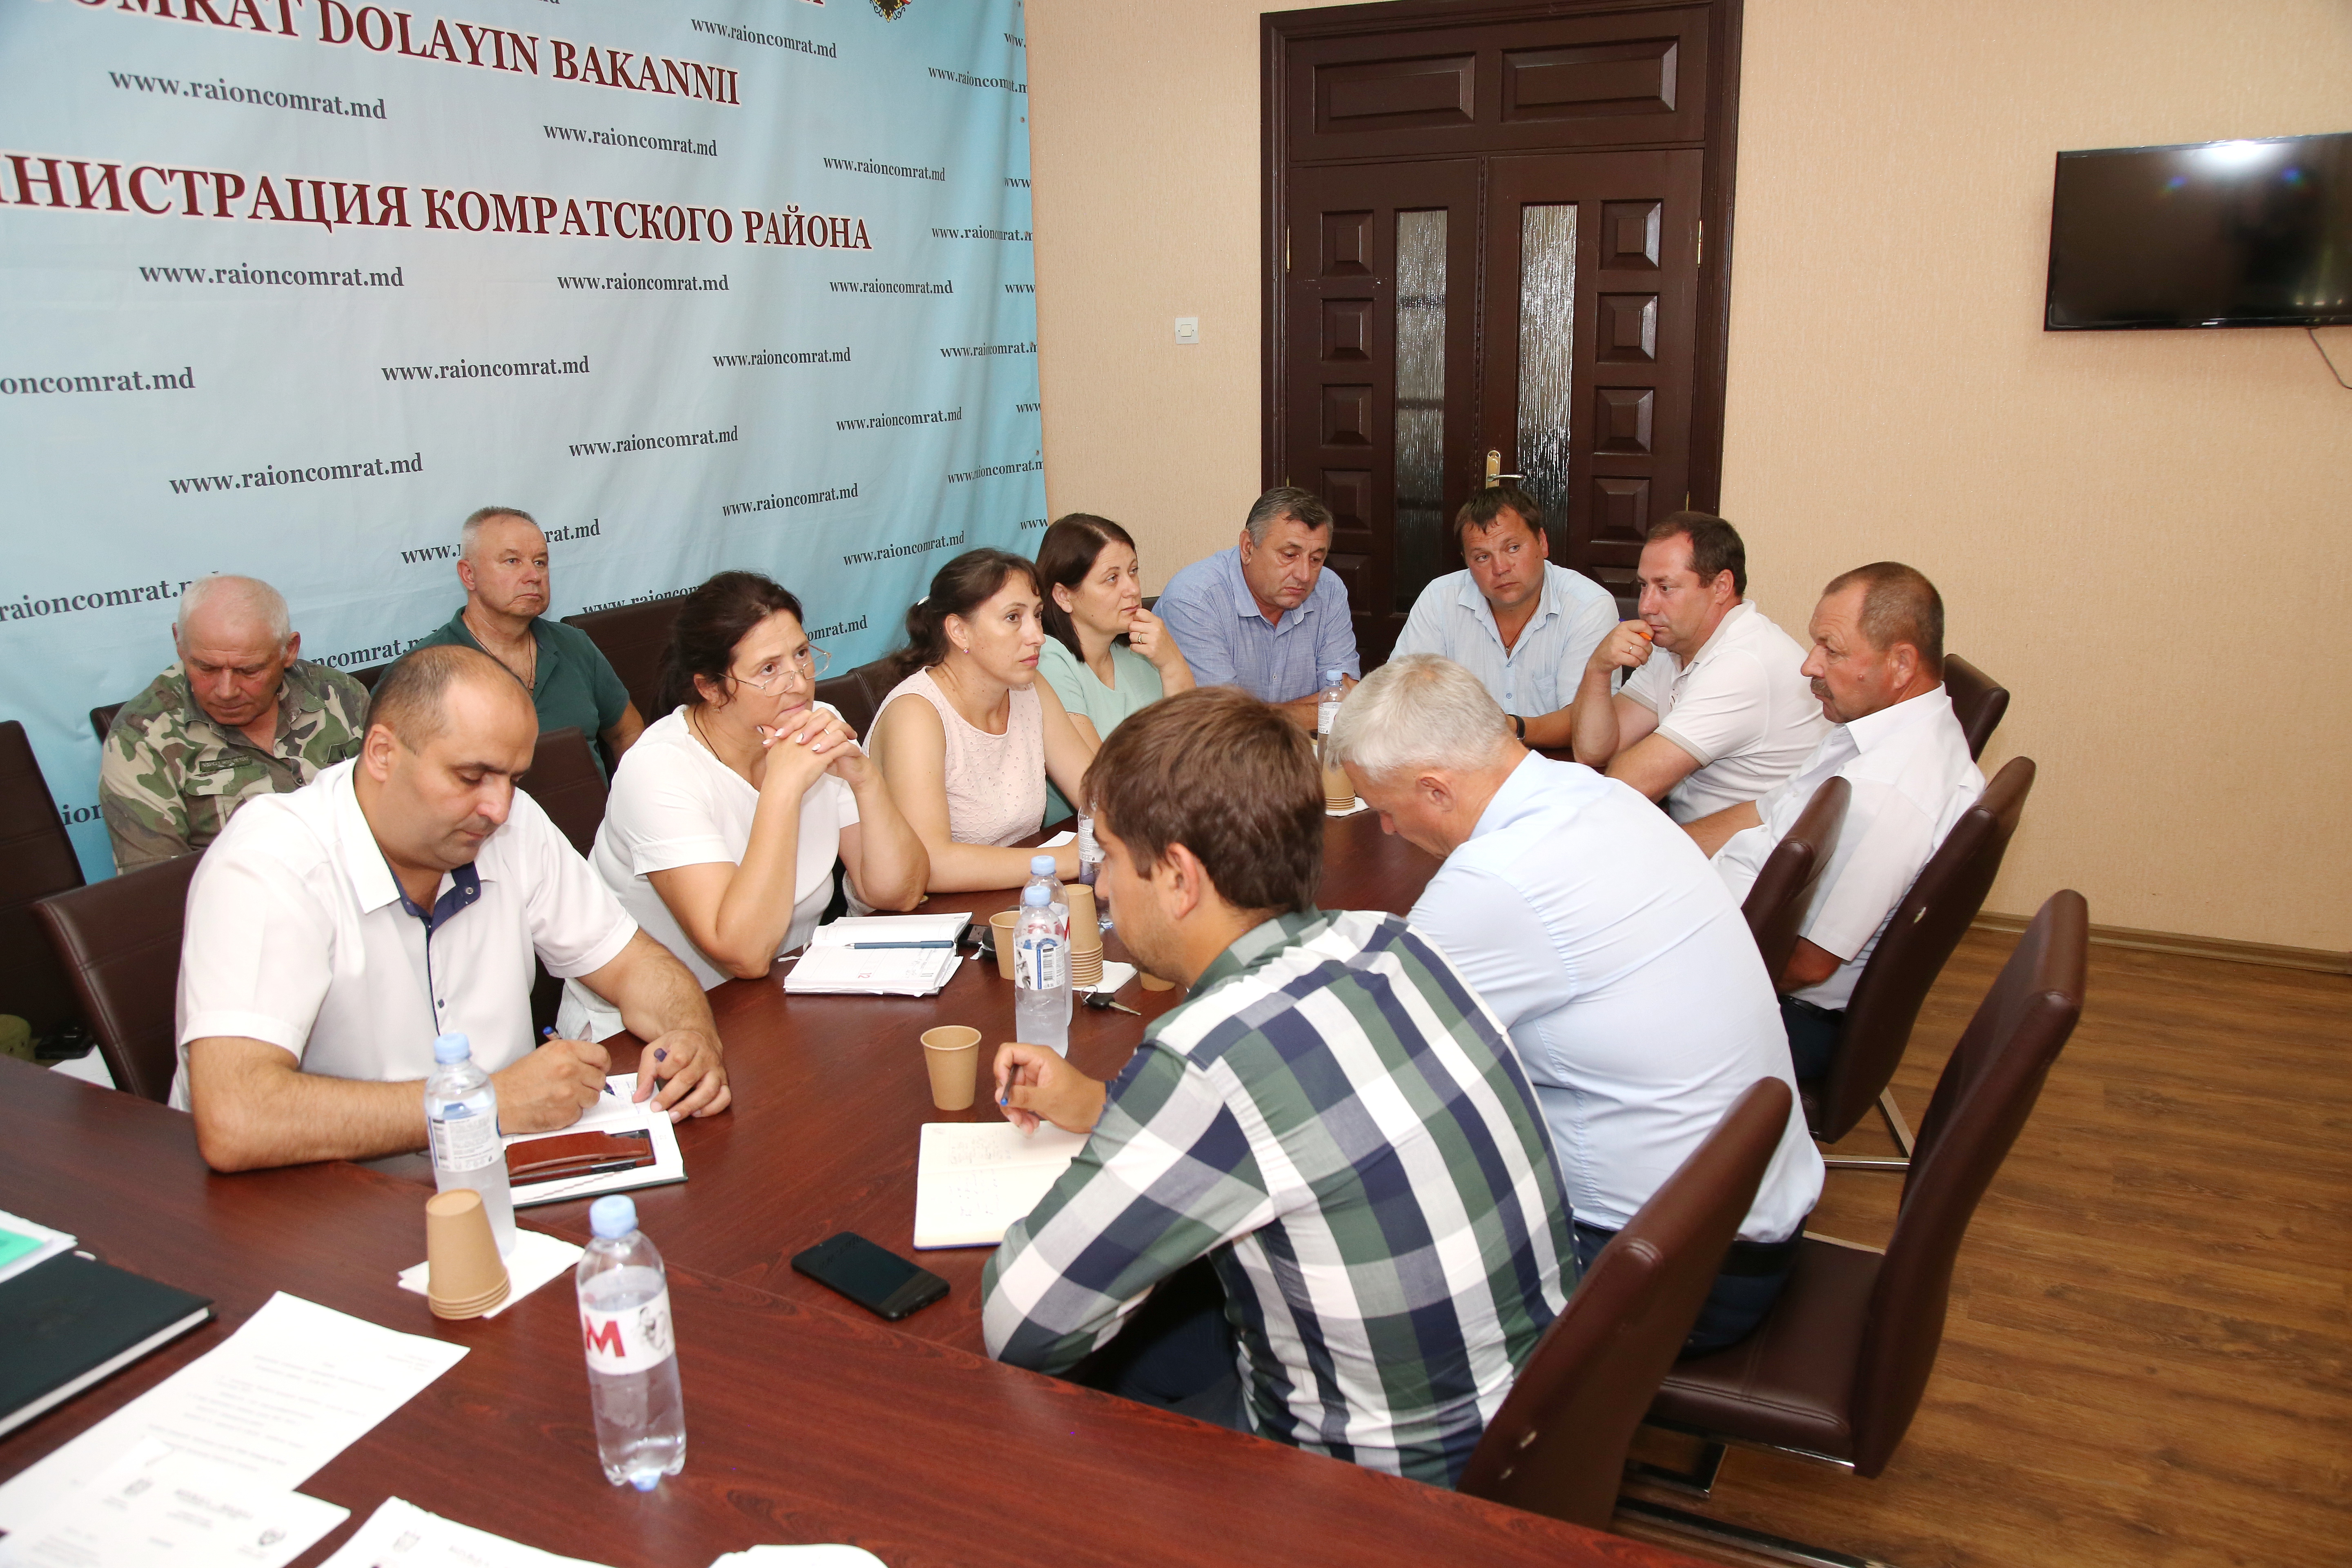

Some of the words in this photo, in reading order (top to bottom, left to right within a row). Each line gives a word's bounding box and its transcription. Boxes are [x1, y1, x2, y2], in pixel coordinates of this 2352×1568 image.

[318, 0, 539, 75] DOLAYIN
[550, 40, 740, 105] BAKANNII
[691, 19, 837, 58] www.raioncomrat.md
[109, 72, 387, 119] www.raioncomrat.md
[543, 126, 717, 156] www.raioncomrat.md
[823, 158, 945, 181] www.raioncomrat.md
[0, 155, 411, 233] НИСТРАЦИЯ
[421, 189, 733, 243] КОМРАТСКОГО
[742, 205, 872, 249] РАЙОНА
[139, 263, 404, 286] www.raioncomrat.md
[557, 272, 729, 290] www.raioncomrat.md
[830, 278, 953, 294] www.raioncomrat.md
[381, 355, 590, 381] www.raioncomrat.md
[713, 347, 851, 367] www.raioncomrat.md
[0, 367, 196, 394] oncomrat.md
[836, 407, 962, 431] www.raioncomrat.md
[569, 425, 738, 456] www.raioncomrat.md
[169, 452, 423, 494] www.raioncomrat.md
[722, 483, 858, 516] www.raioncomrat.md
[843, 530, 964, 566] www.raioncomrat.md
[804, 615, 868, 641] omrat.md
